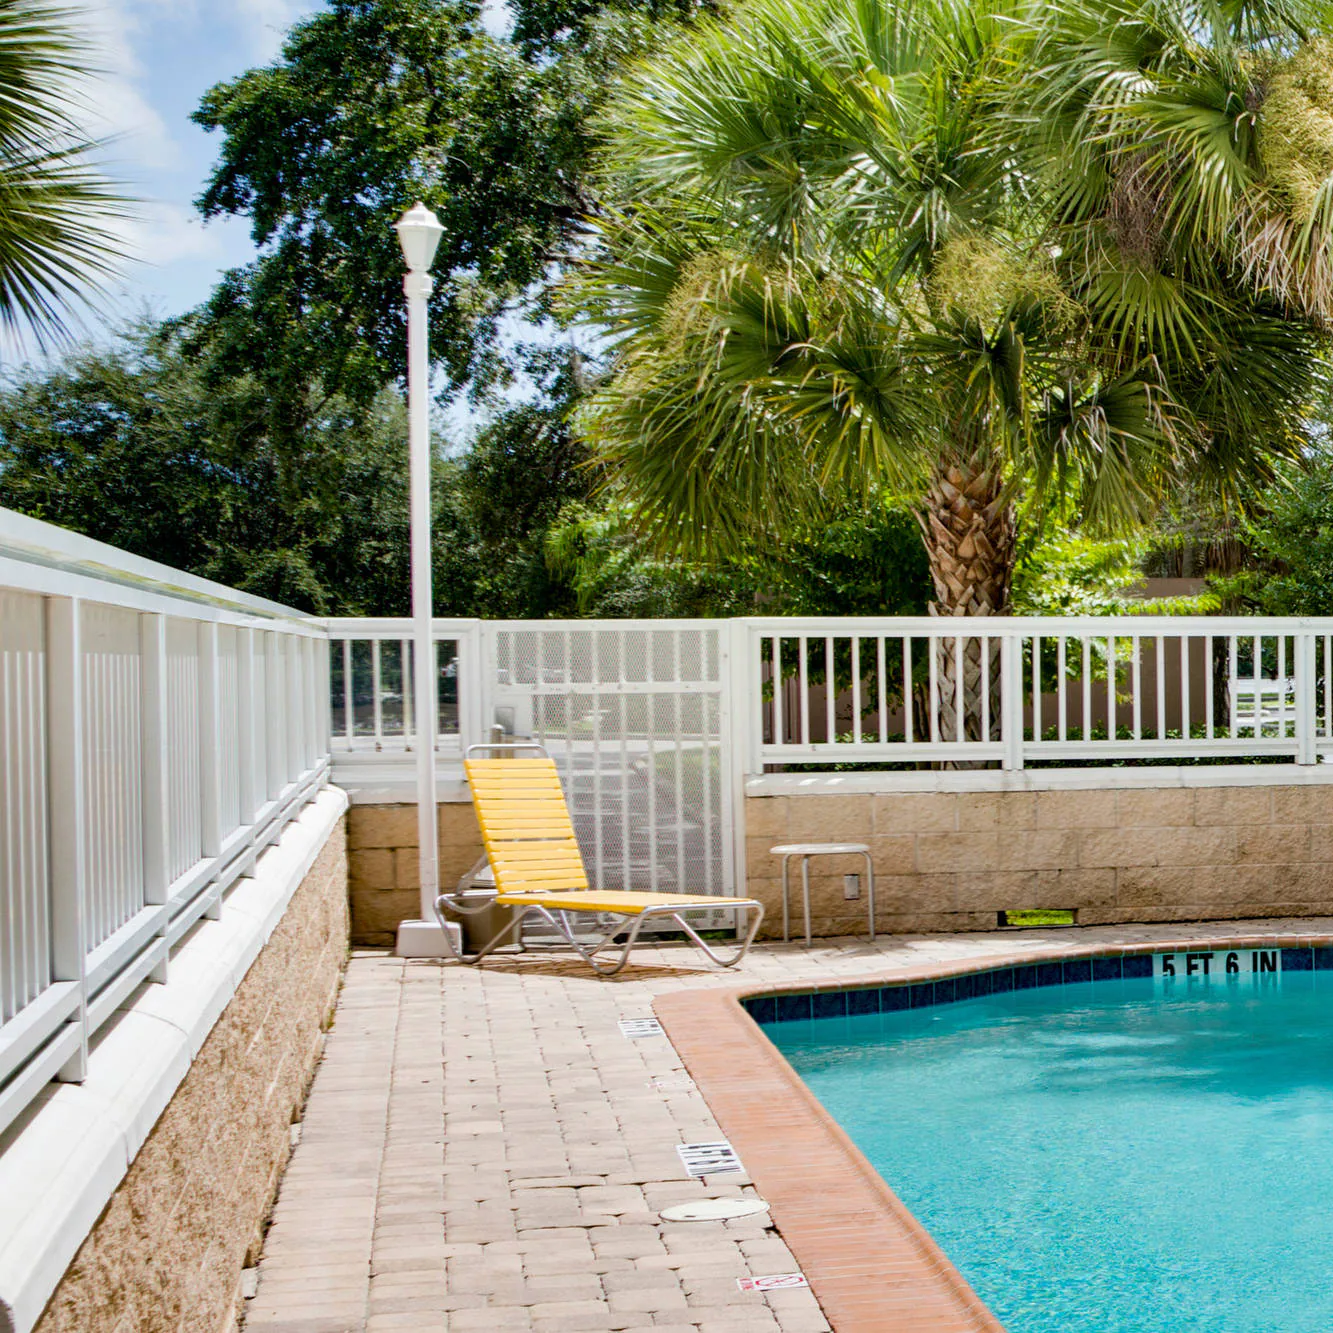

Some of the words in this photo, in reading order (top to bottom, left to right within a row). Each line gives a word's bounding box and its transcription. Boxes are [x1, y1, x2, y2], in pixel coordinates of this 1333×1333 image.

[1162, 954, 1175, 976] 5
[1186, 952, 1213, 975] FT
[1226, 952, 1239, 973] 6
[1252, 951, 1276, 972] IN
